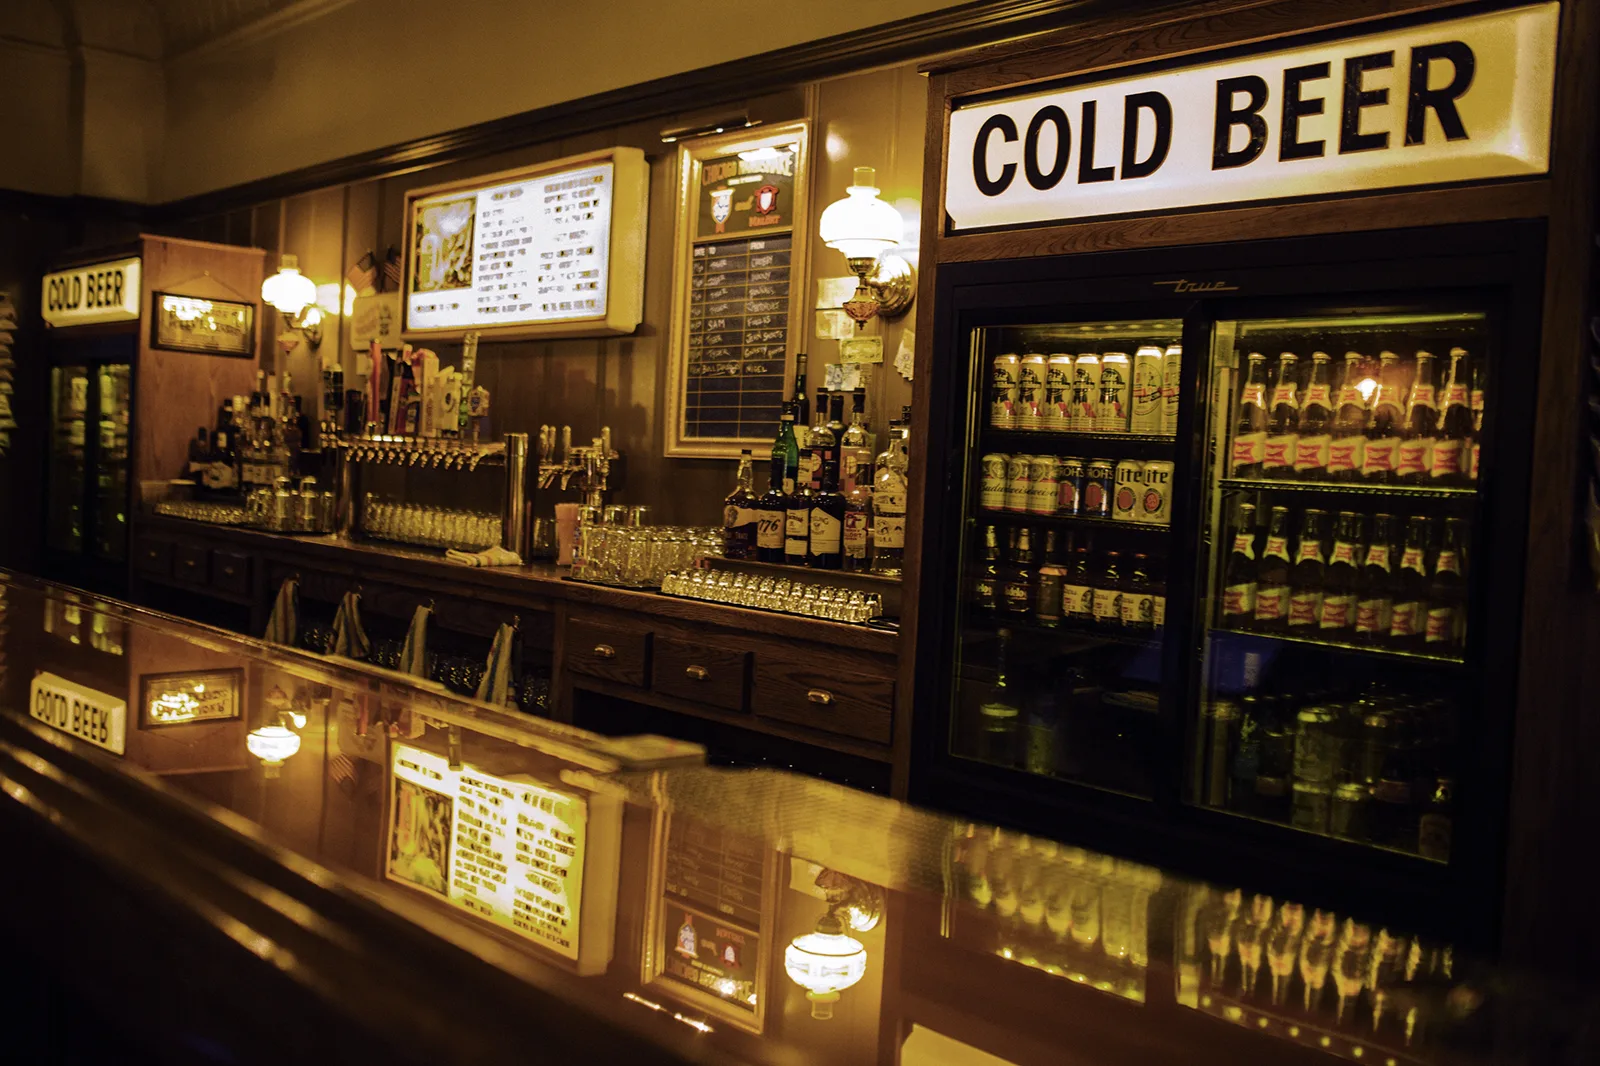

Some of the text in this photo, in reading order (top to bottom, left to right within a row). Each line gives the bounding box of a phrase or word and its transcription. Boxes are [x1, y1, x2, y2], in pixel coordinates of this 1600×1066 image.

[972, 39, 1478, 197] COLD BEER
[48, 271, 124, 312] COLD BEER
[1116, 468, 1143, 486] Lite
[1143, 469, 1169, 487] Lite
